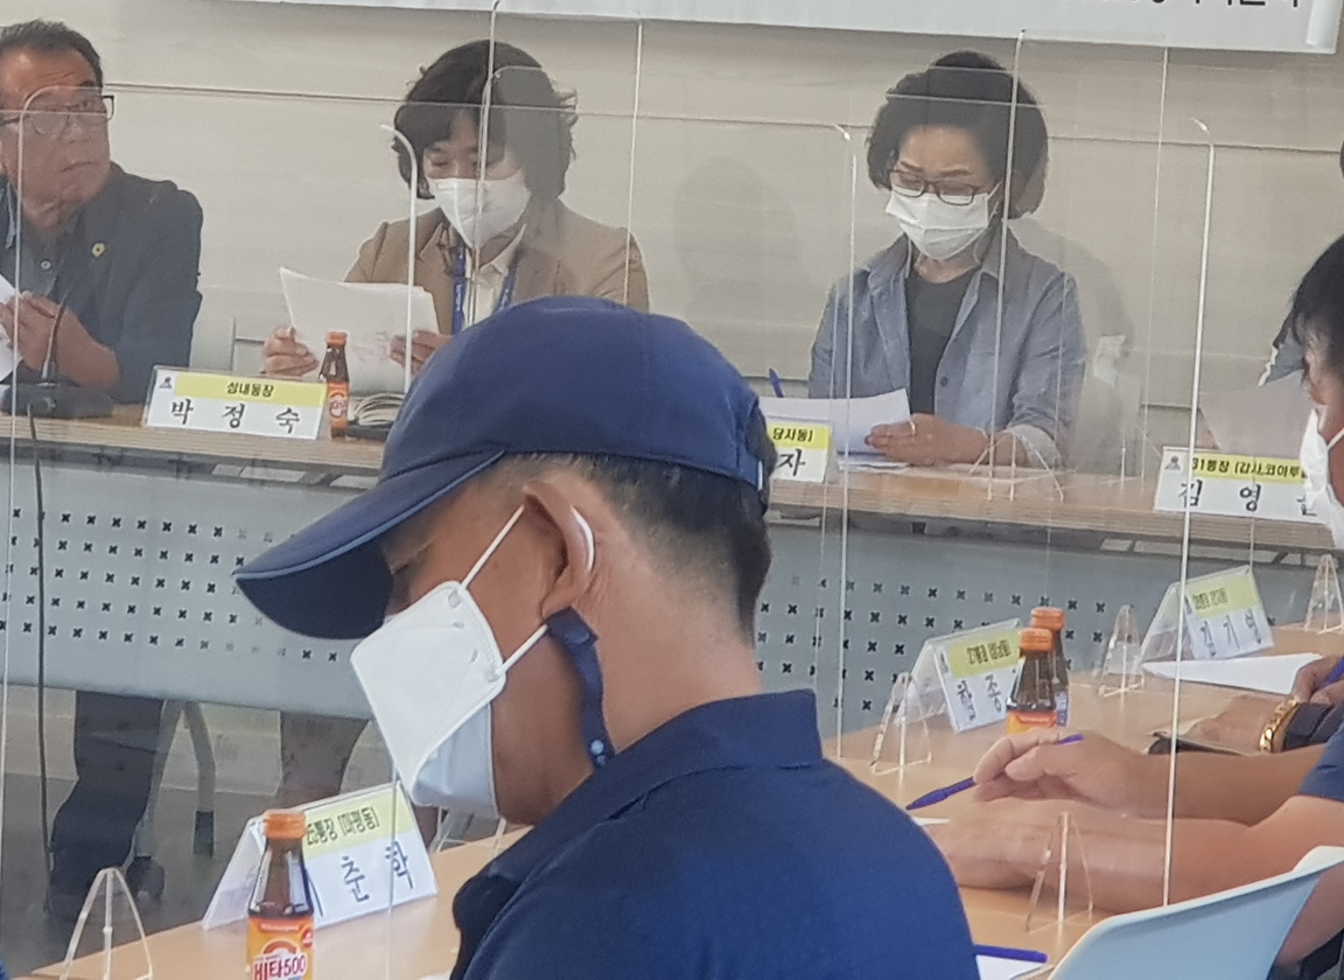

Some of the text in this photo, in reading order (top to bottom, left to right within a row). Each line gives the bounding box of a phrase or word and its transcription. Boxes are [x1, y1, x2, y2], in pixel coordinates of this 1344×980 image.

[171, 398, 300, 434] 박 정 숙
[1239, 483, 1262, 512] 영
